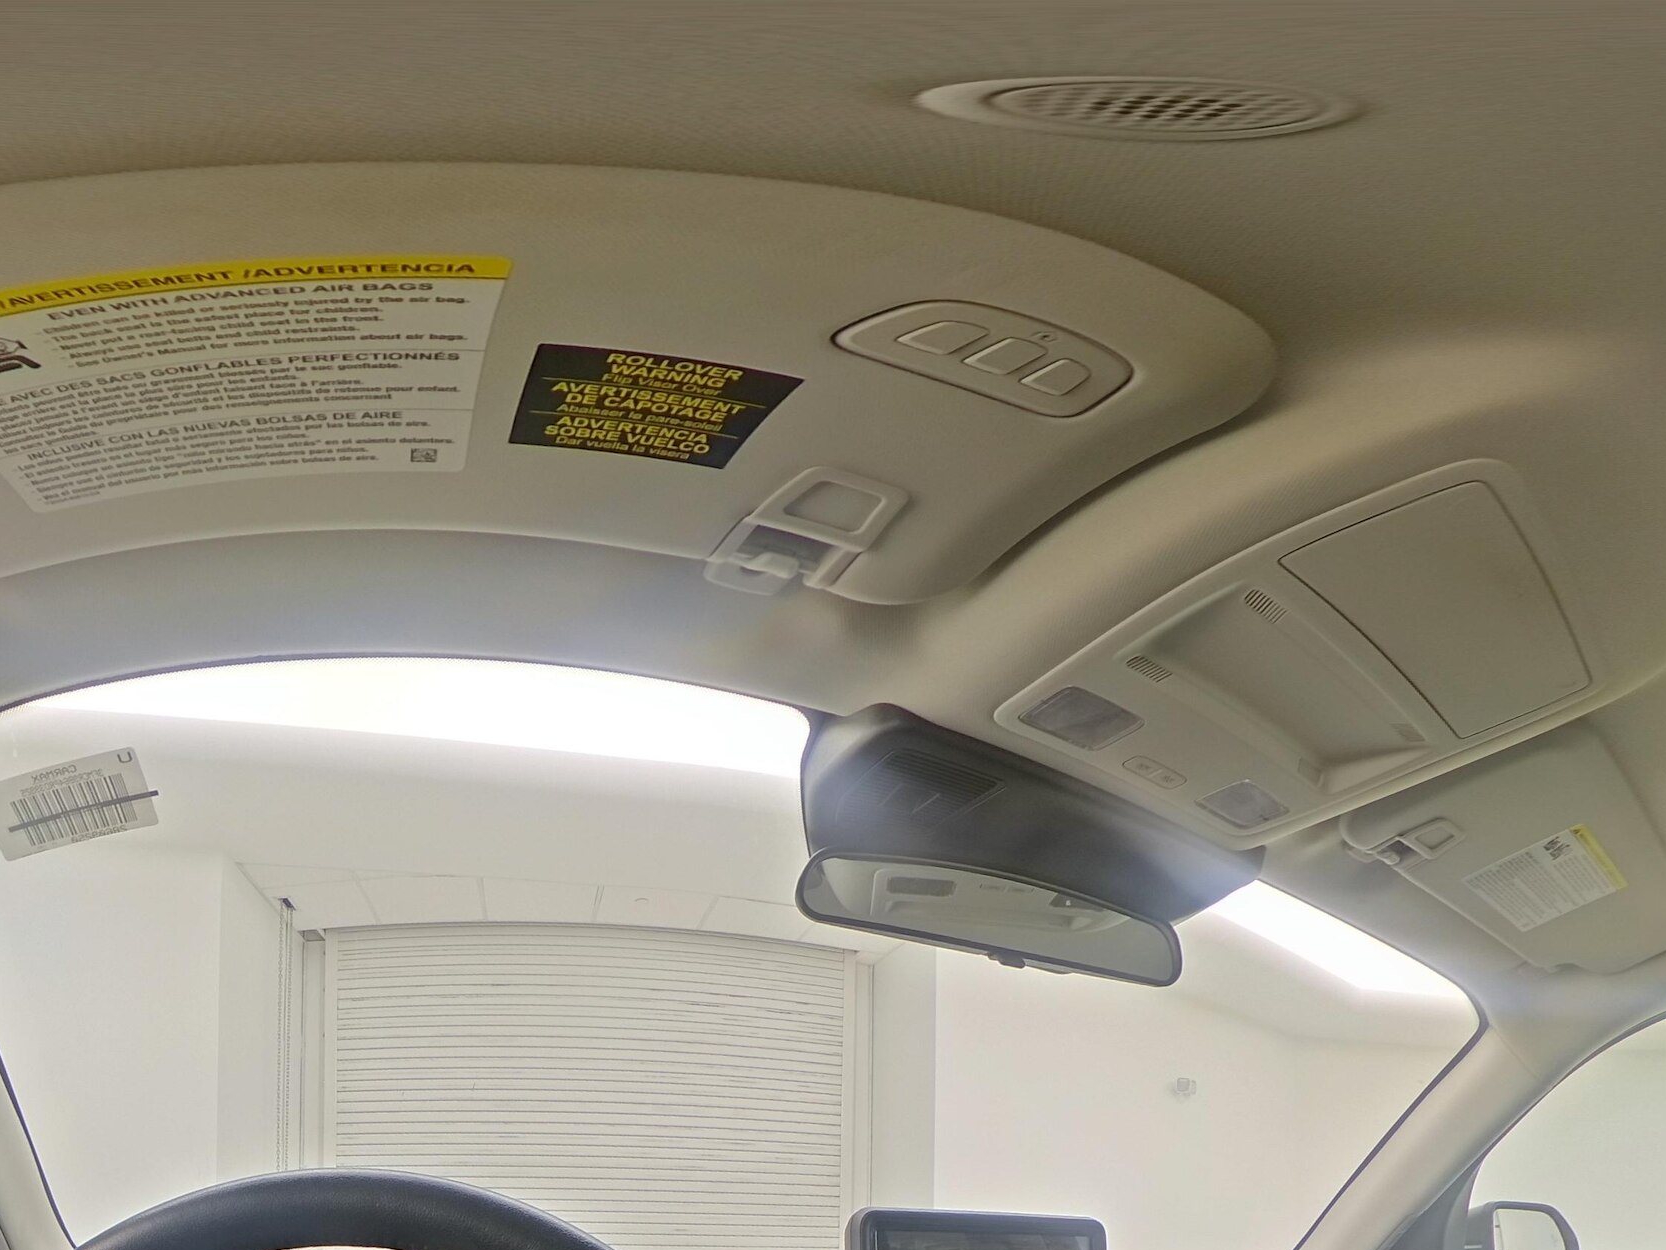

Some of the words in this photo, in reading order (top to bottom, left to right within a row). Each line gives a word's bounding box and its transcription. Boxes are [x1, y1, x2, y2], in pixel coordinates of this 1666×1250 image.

[46, 305, 106, 320] EVEN
[109, 297, 169, 310] WITH
[172, 286, 305, 303] ADVANCED
[311, 283, 354, 293] AIR
[361, 282, 433, 291] BAGS
[8, 388, 53, 403] AVEC
[56, 380, 93, 393] DES
[96, 371, 146, 386] SACS
[150, 357, 282, 378] GONFLABLES
[286, 350, 460, 364] PERFECTIONNÉS
[605, 353, 745, 380] ROLLOVER
[608, 363, 728, 388] WARNING
[551, 381, 747, 415] AVERTISSEMENT
[599, 373, 634, 383] Flip
[636, 377, 679, 389] Visor
[680, 383, 722, 396] Over
[564, 392, 598, 404] DE
[602, 396, 727, 422] CAPOTAGE
[27, 439, 105, 461] INCLUSIVE
[108, 432, 143, 444] CON
[147, 427, 179, 438] LAS
[183, 419, 250, 433] NUEVAS
[254, 412, 327, 425] BOLSAS
[331, 411, 356, 420] DE
[361, 411, 402, 419] AIRE
[544, 424, 621, 441] SOBRE
[624, 433, 711, 454] VUELCO
[557, 415, 710, 443] ADVERTENCIA
[555, 436, 582, 445] Dar
[631, 444, 646, 452] la
[648, 446, 691, 459] visera
